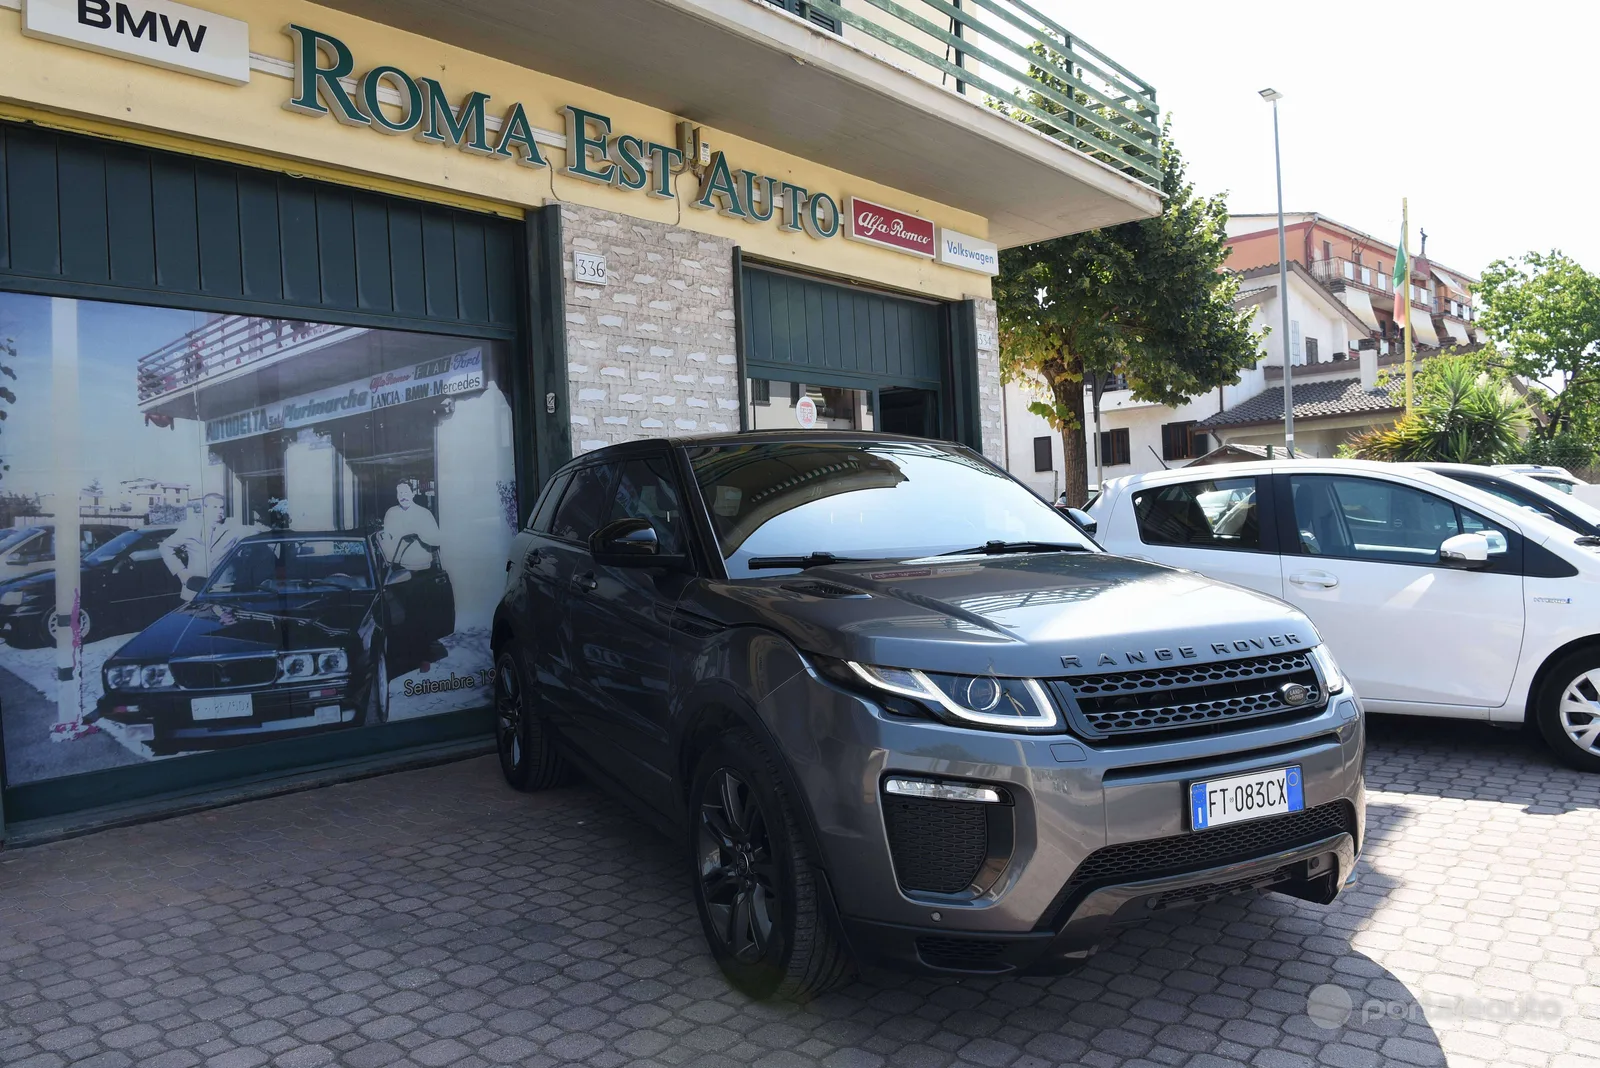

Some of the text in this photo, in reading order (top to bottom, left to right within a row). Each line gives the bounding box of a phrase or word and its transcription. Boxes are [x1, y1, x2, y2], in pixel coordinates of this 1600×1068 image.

[77, 0, 208, 53] BMW
[286, 22, 840, 239] ROMA EST AUTO
[857, 211, 931, 245] Alfa Romeo
[576, 258, 606, 280] 336
[946, 239, 995, 265] Volkswagen
[415, 357, 449, 379] FIAT
[453, 350, 481, 371] Ford
[371, 373, 481, 410] LANCIA BMW Mercedes
[1060, 632, 1302, 669] RANGE ROVER
[403, 671, 475, 698] Settembre
[1208, 777, 1287, 818] FT 083CX
